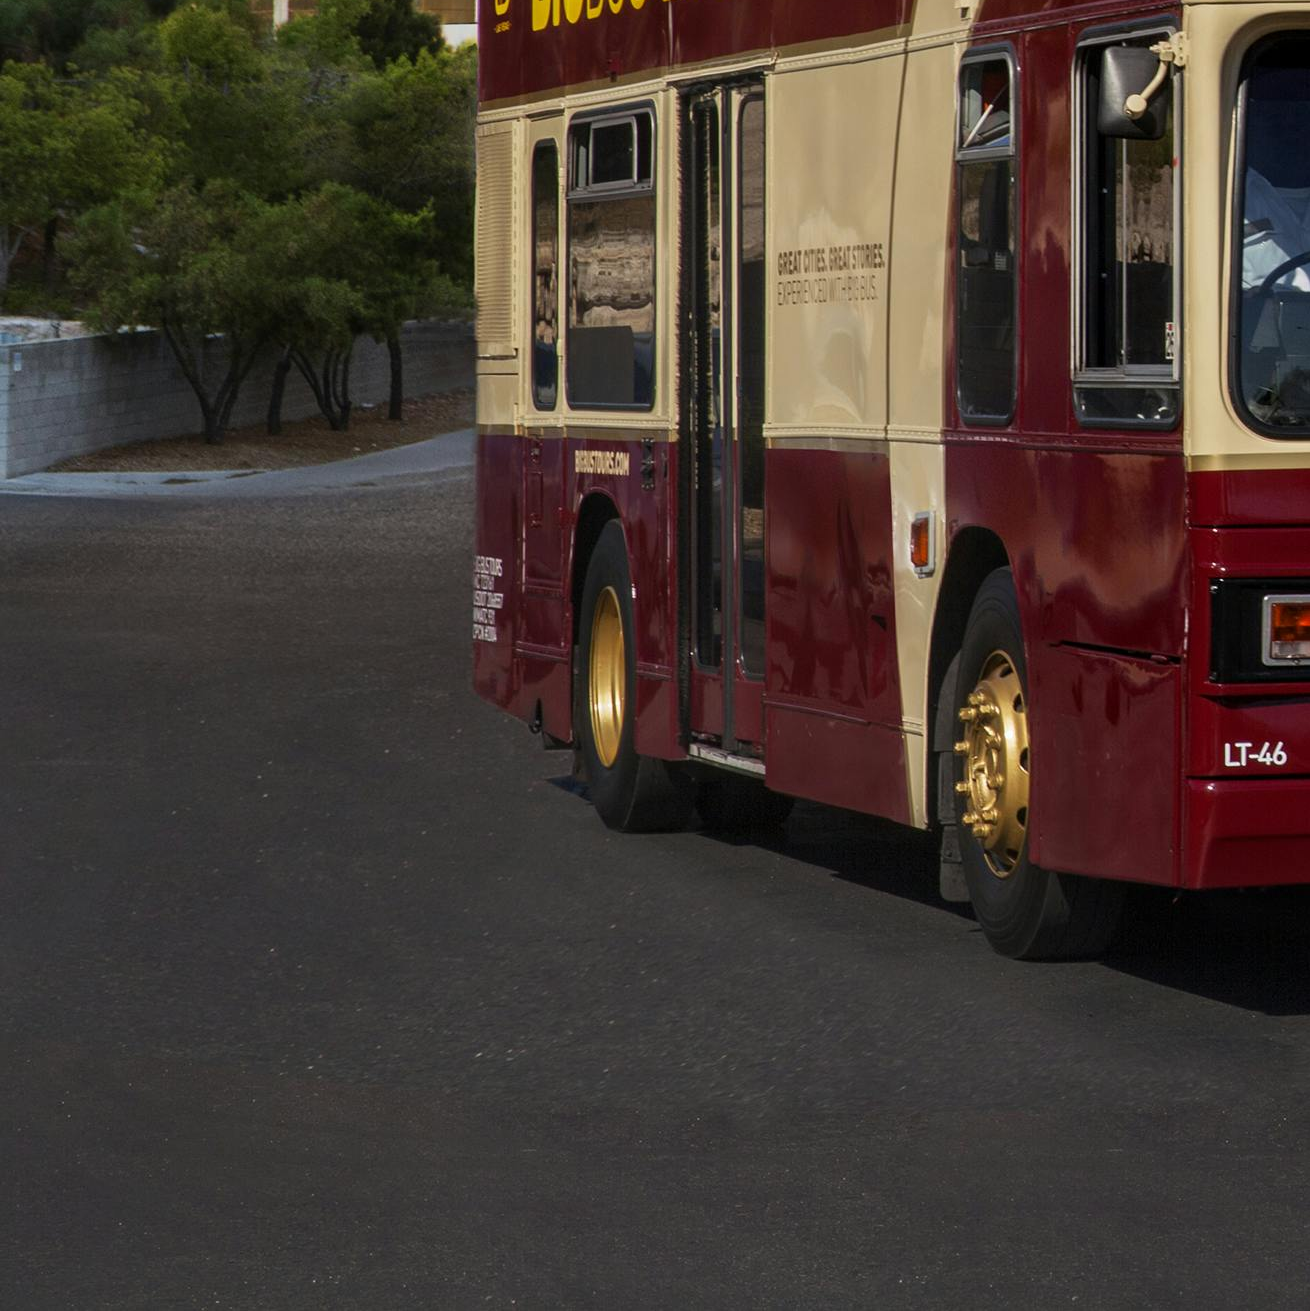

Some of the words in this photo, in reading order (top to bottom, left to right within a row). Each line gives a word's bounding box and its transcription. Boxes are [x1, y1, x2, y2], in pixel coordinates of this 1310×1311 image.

[778, 250, 801, 276] GREAT
[829, 245, 851, 272] GREAT
[1224, 741, 1288, 767] LT-46
